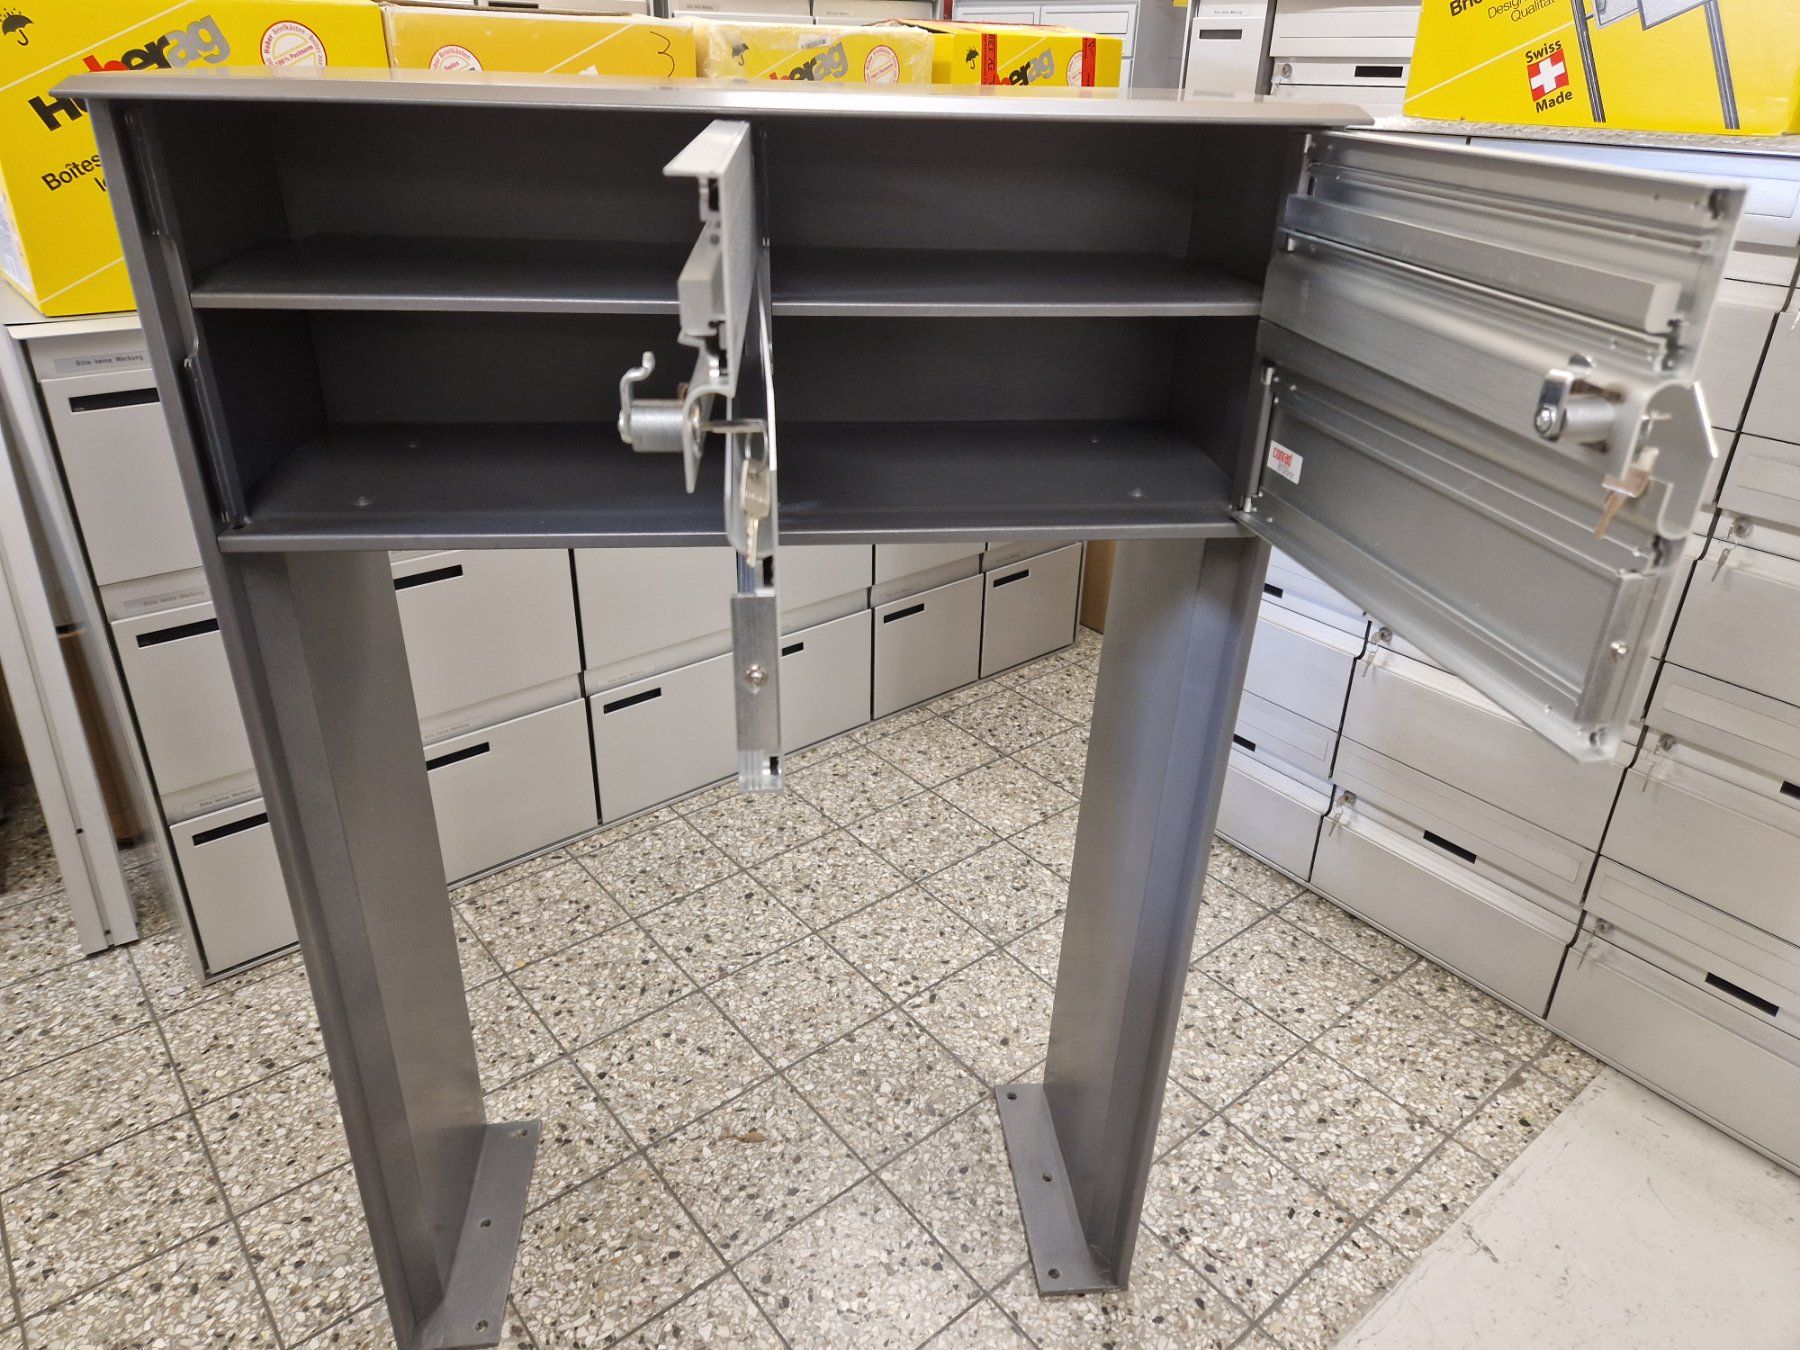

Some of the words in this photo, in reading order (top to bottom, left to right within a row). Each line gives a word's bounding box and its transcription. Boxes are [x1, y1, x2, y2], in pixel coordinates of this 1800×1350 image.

[1488, 0, 1522, 18] Desig
[1525, 40, 1562, 63] Swiss
[1535, 90, 1573, 113] Made
[41, 154, 102, 191] Boîtes
